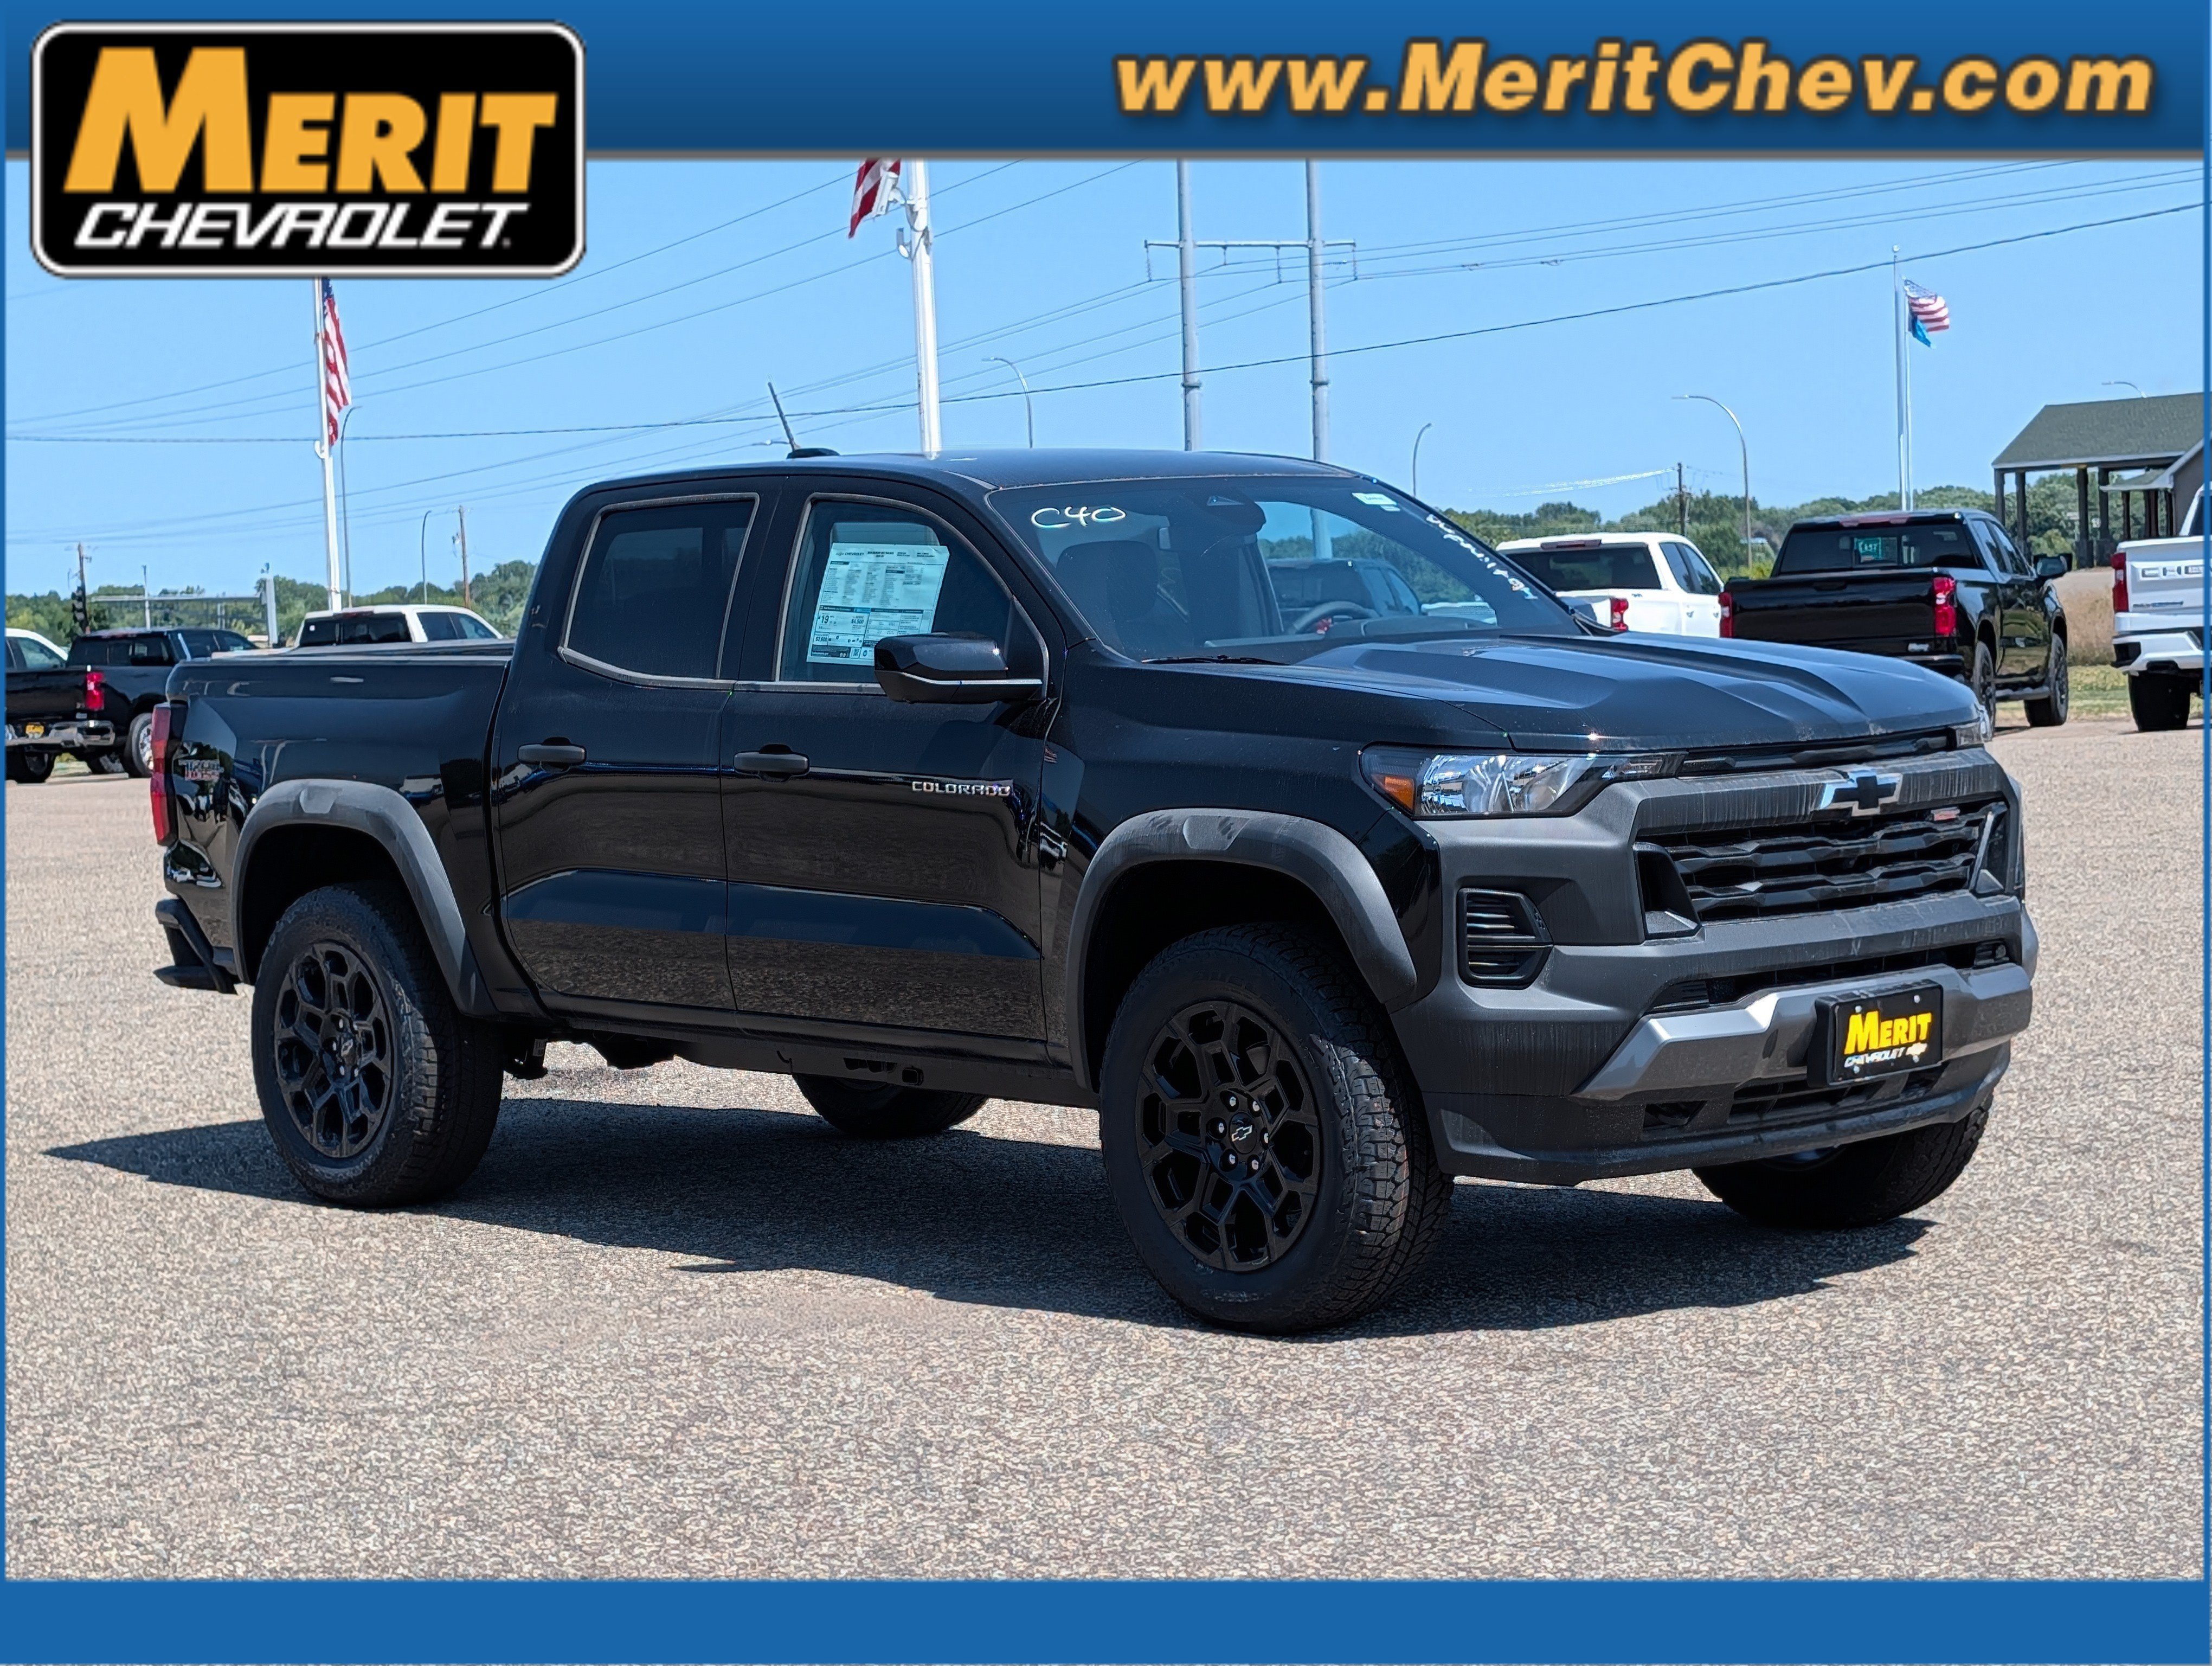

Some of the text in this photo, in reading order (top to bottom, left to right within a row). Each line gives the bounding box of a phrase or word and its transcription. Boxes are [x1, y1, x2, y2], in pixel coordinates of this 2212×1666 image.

[821, 615, 829, 624] 19
[912, 781, 1011, 796] COLORADO
[1844, 1011, 1932, 1054] MERIT
